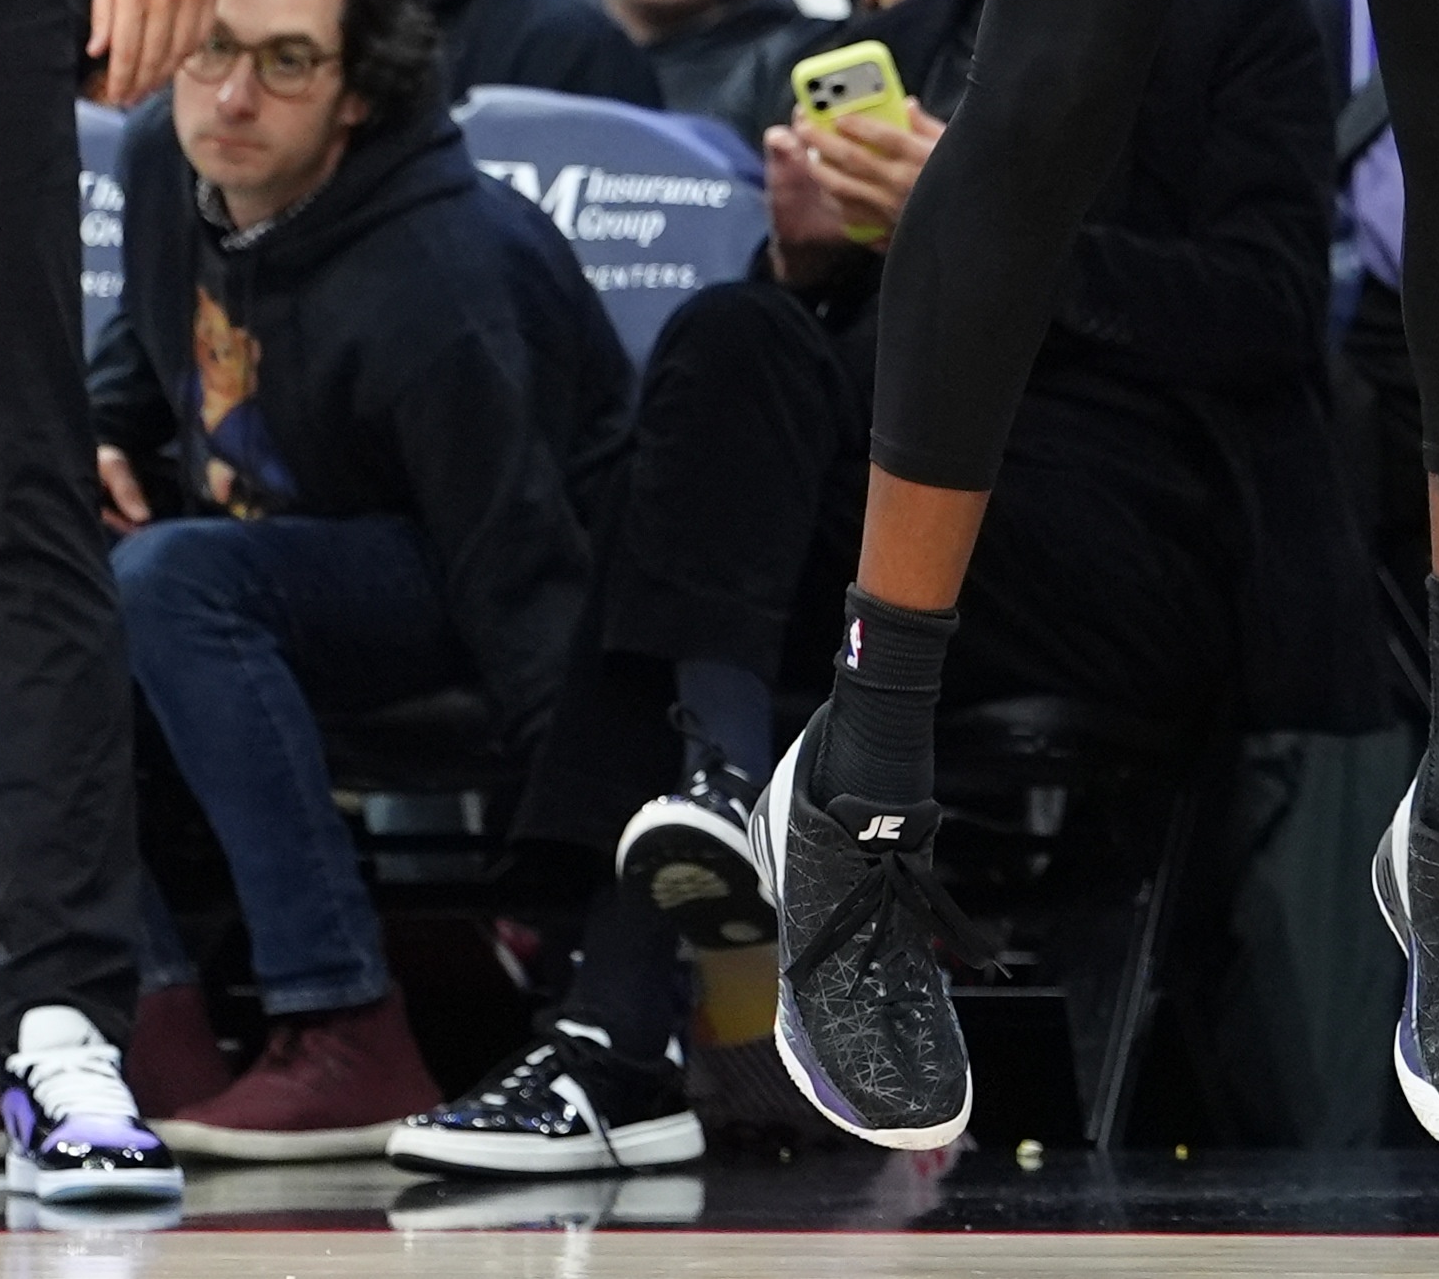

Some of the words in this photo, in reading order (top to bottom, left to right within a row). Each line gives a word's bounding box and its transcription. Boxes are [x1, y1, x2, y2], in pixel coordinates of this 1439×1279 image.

[584, 167, 733, 209] Insurance
[577, 203, 668, 249] Group
[857, 814, 906, 842] JE
